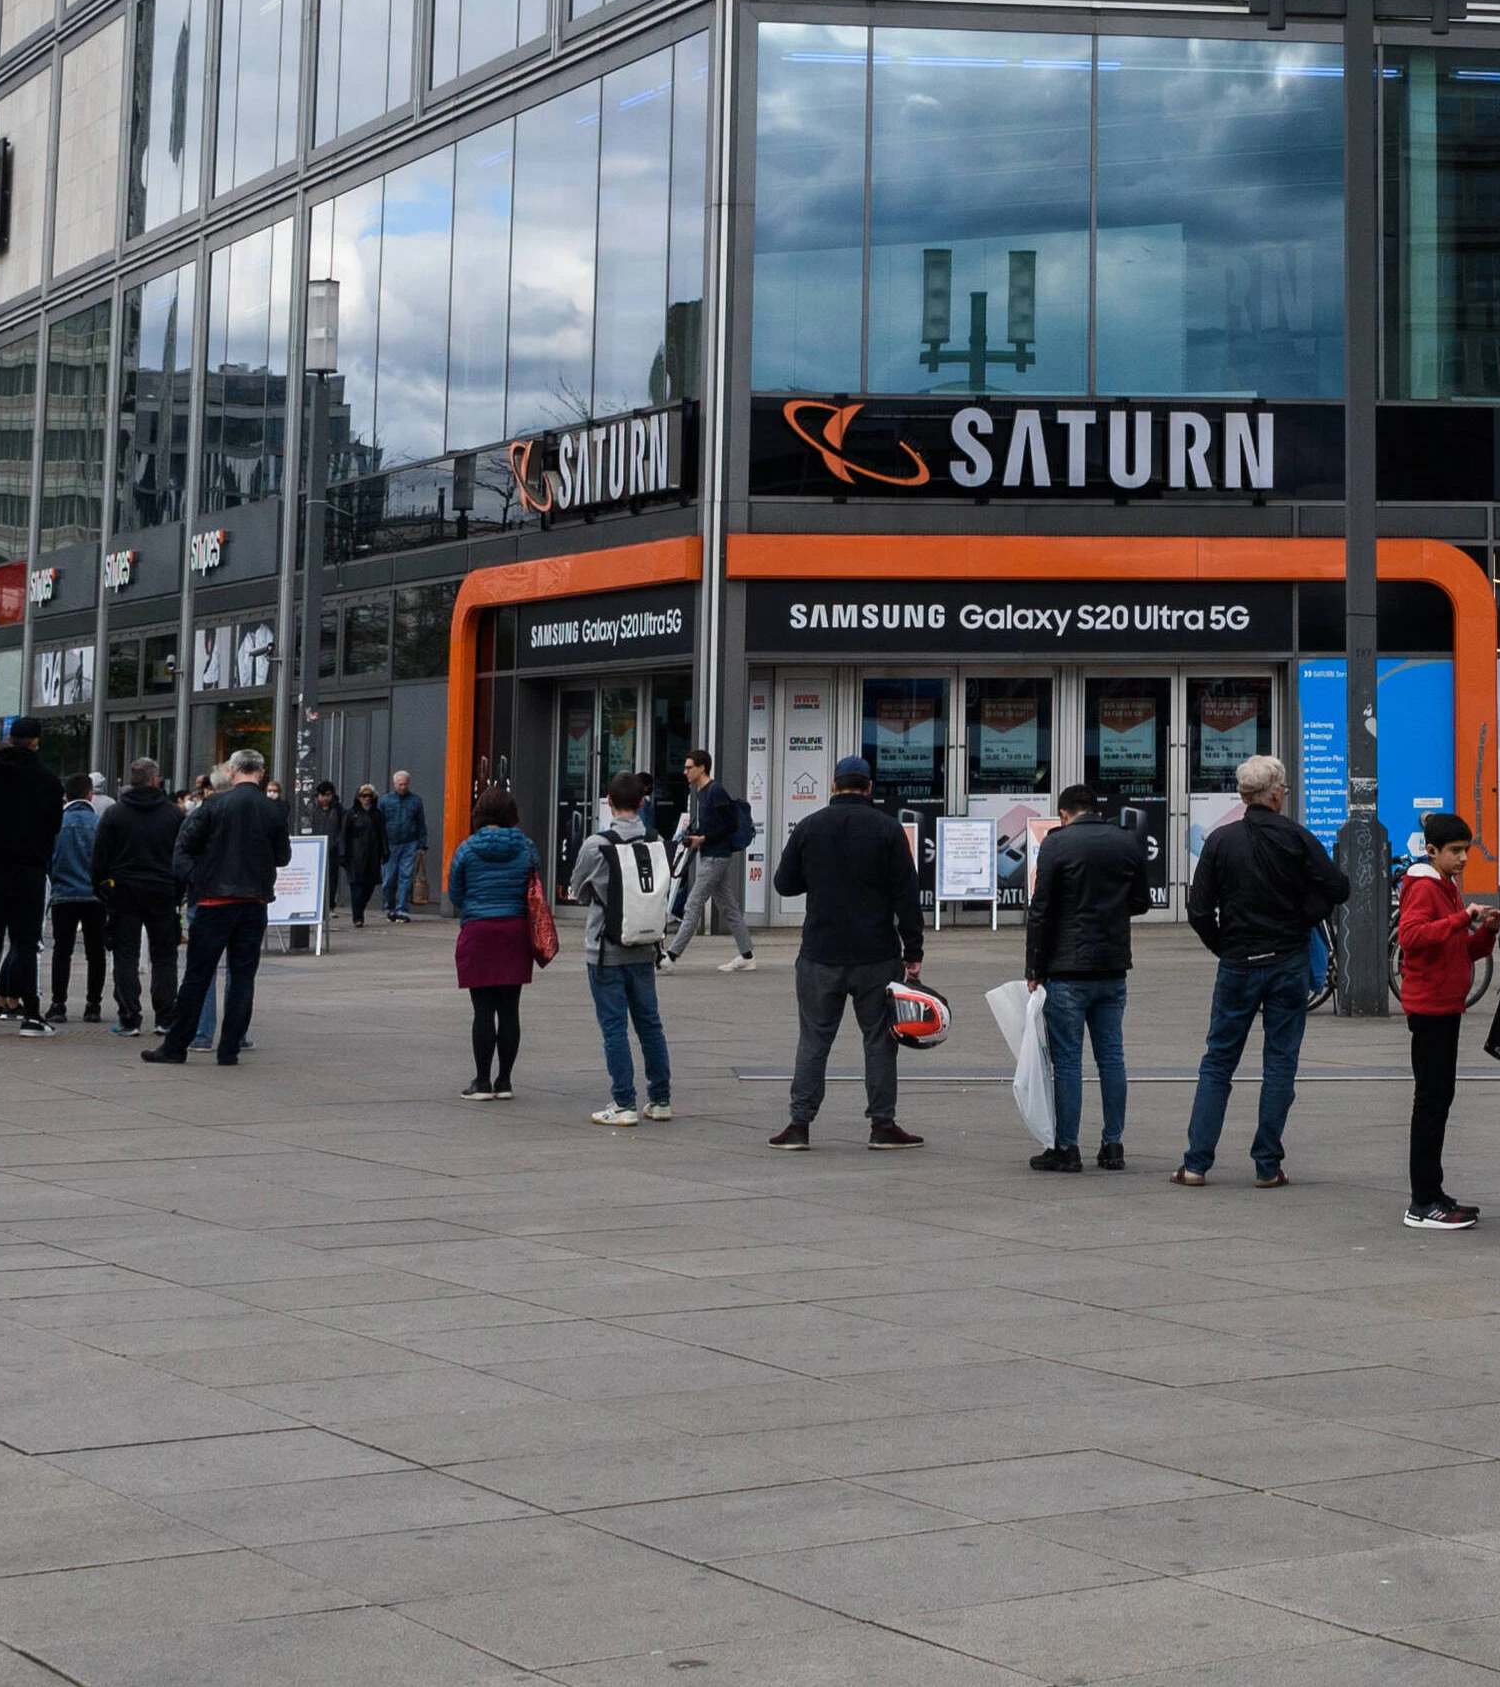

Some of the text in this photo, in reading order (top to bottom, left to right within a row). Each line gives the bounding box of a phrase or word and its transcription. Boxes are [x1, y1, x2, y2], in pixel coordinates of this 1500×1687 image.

[557, 410, 672, 512] SATURN
[949, 407, 1276, 490] SATURN
[530, 609, 682, 649] SAMSUNG Galaxy S20 Ultra 5G
[790, 603, 1249, 637] SAMSUNG Galaxy S20 Ultra 5G
[790, 736, 823, 745] ONLINE
